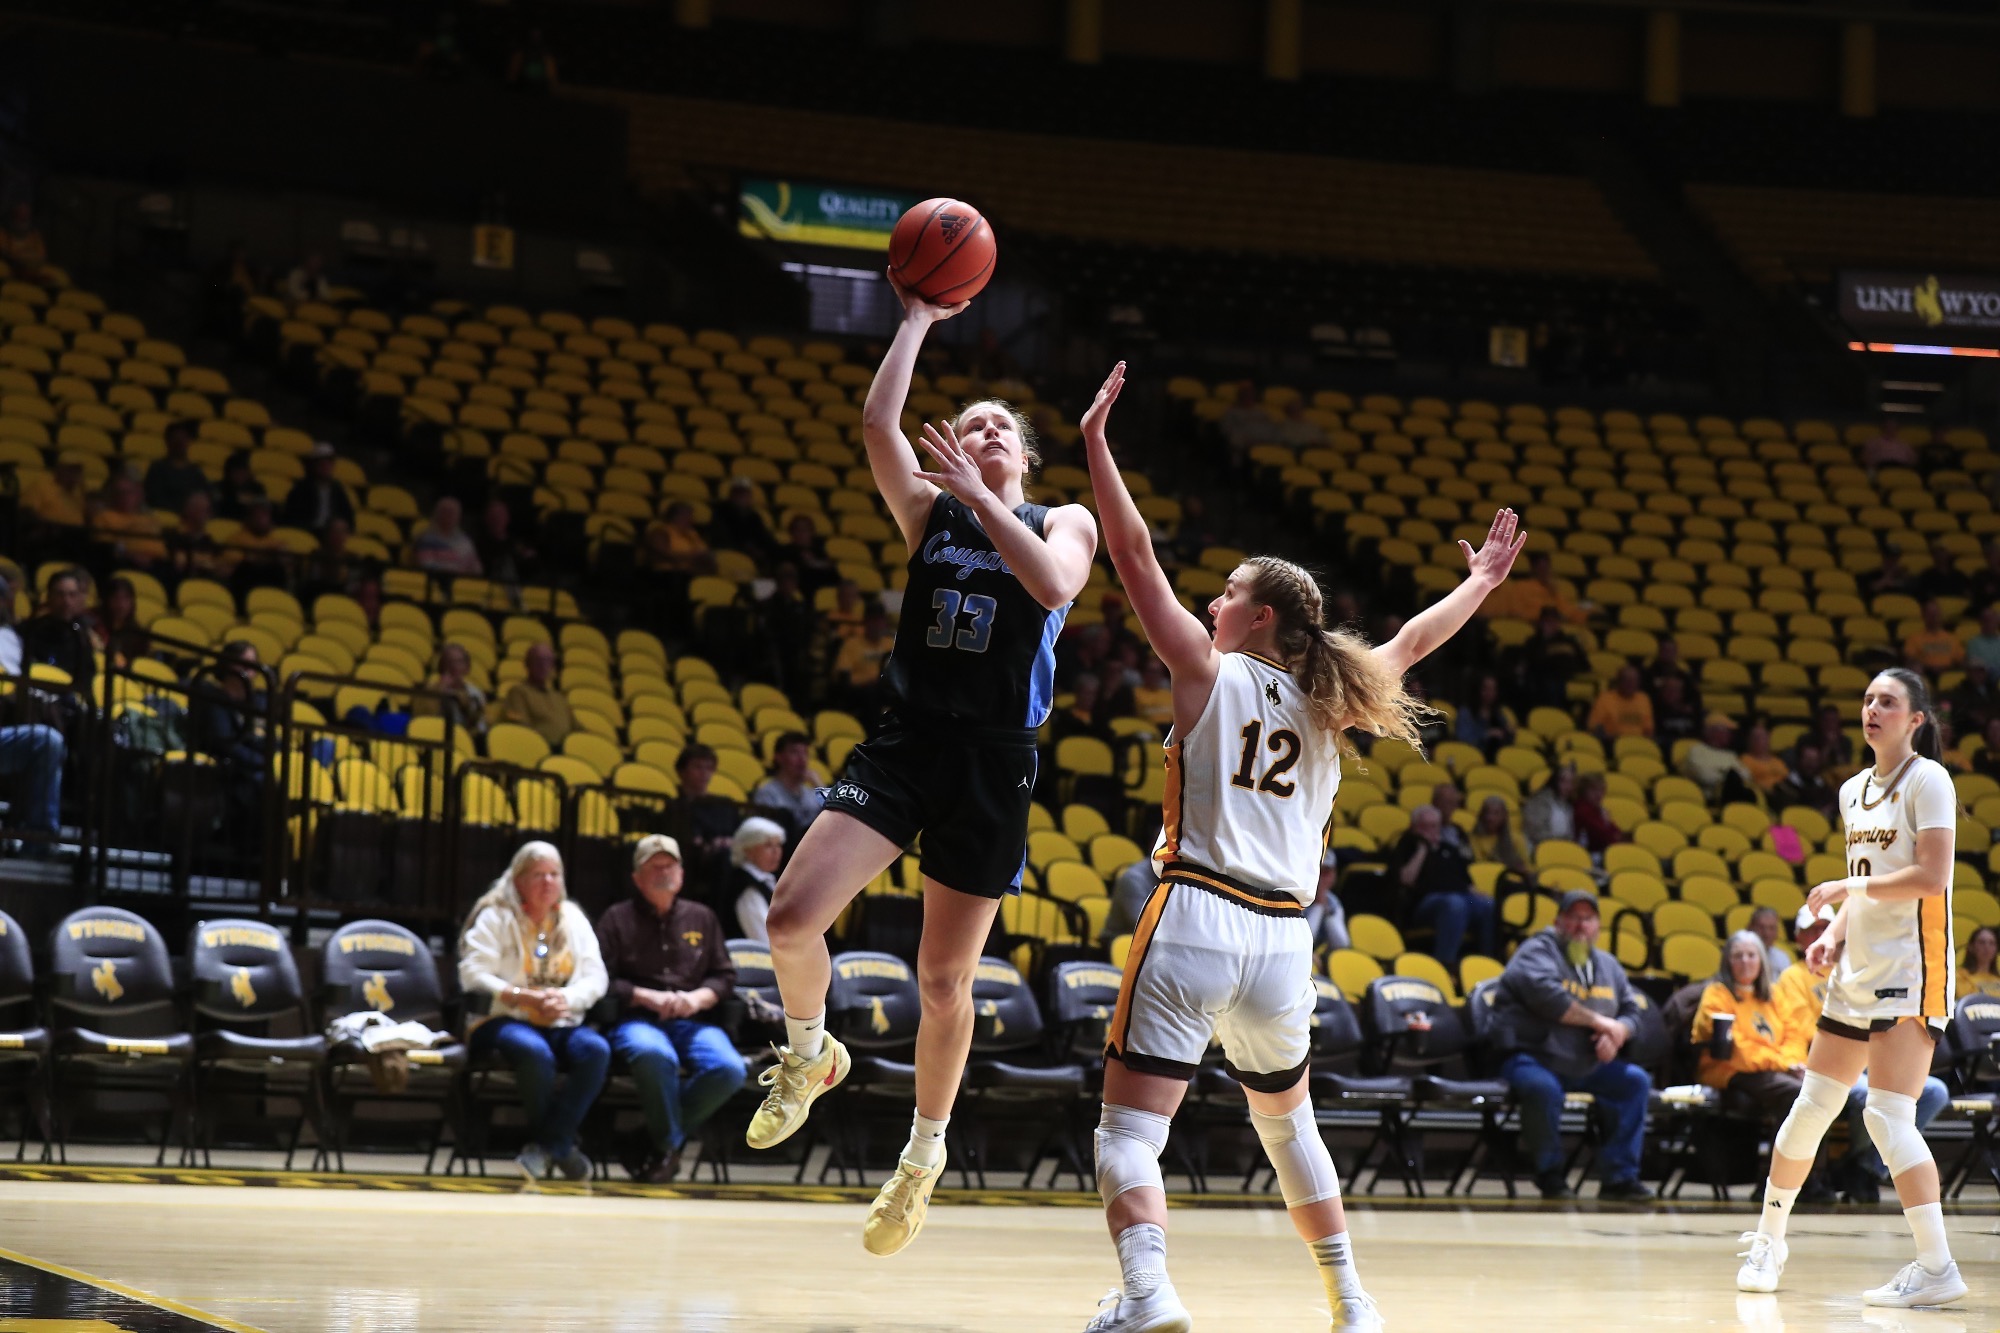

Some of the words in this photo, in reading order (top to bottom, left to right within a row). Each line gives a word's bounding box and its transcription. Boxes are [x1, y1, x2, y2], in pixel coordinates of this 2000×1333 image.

[818, 189, 899, 218] QUALITY
[944, 215, 971, 245] adidas
[1854, 284, 1913, 313] UNI
[923, 529, 1015, 581] Couga
[926, 587, 997, 653] 33
[1230, 718, 1301, 799] 12
[836, 783, 869, 806] CCU
